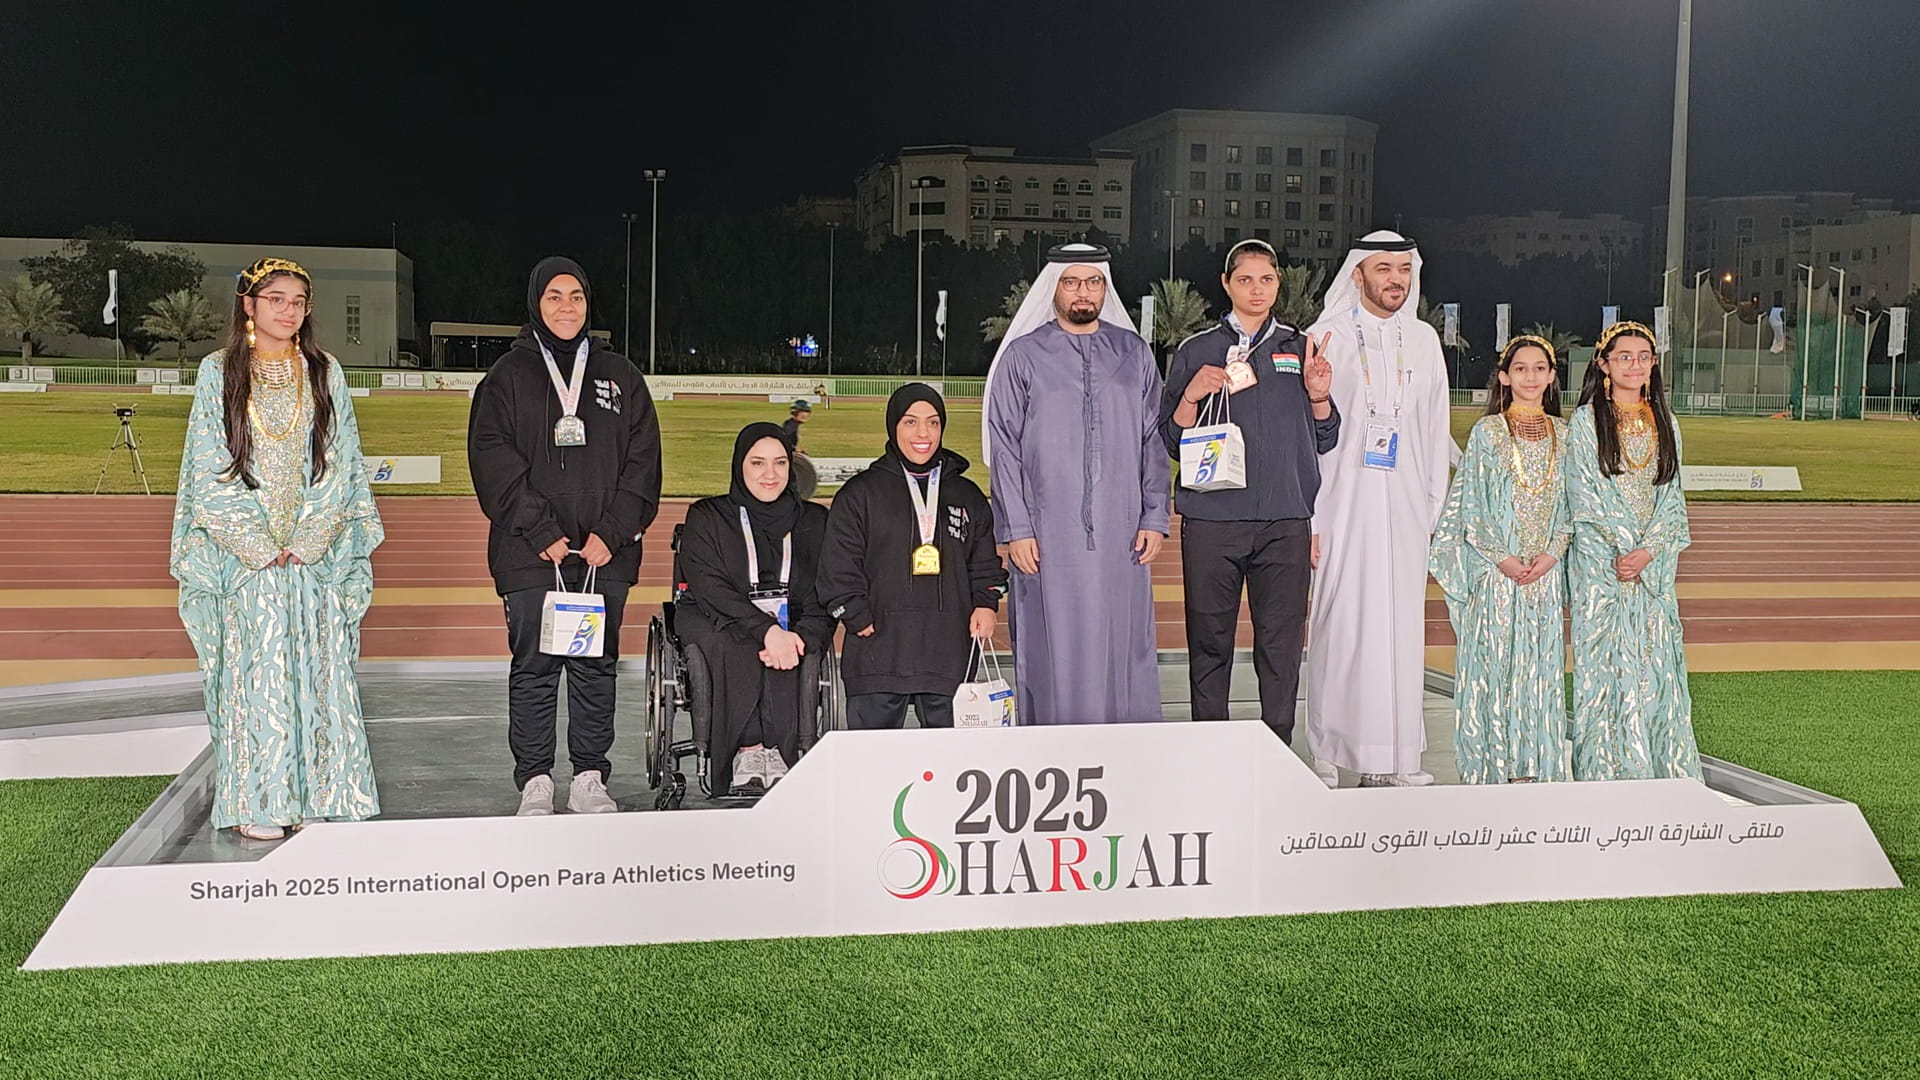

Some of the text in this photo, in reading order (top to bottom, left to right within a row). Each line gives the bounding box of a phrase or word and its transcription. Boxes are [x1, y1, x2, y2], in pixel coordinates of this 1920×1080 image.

[1275, 366, 1302, 375] INDIA
[832, 605, 846, 618] UAE
[955, 765, 1108, 834] 2025
[1280, 821, 1785, 855] ملتقى الشارقة الدولي الثالث عشر لألعاب القوى للمعاقين
[190, 861, 796, 903] Sharjah 2025 International Open Para Athletics Meeting
